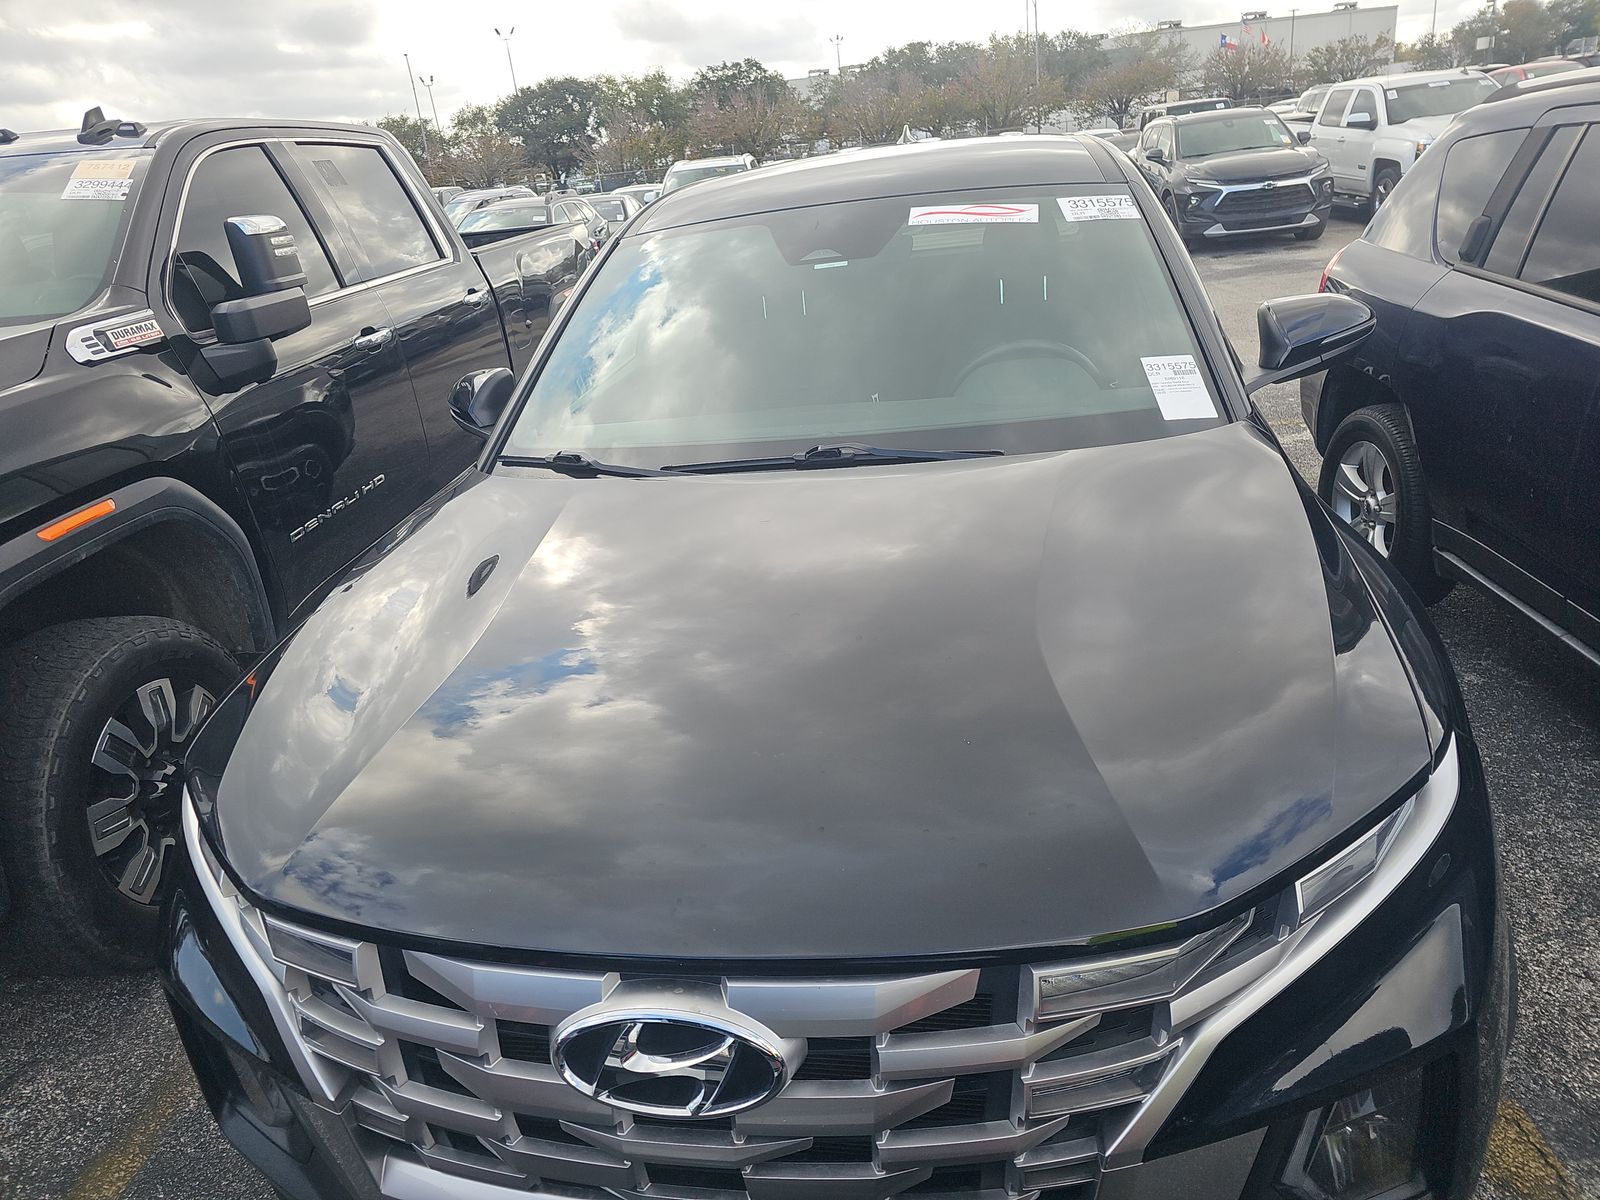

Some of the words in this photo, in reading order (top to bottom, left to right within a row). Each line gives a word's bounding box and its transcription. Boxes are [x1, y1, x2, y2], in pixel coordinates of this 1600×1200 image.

[74, 180, 132, 189] 3299444
[1067, 197, 1135, 209] 3315575
[110, 321, 157, 340] DURAMAX
[1145, 361, 1197, 372] 3315575
[289, 490, 360, 543] DENALI
[361, 473, 385, 495] HD
